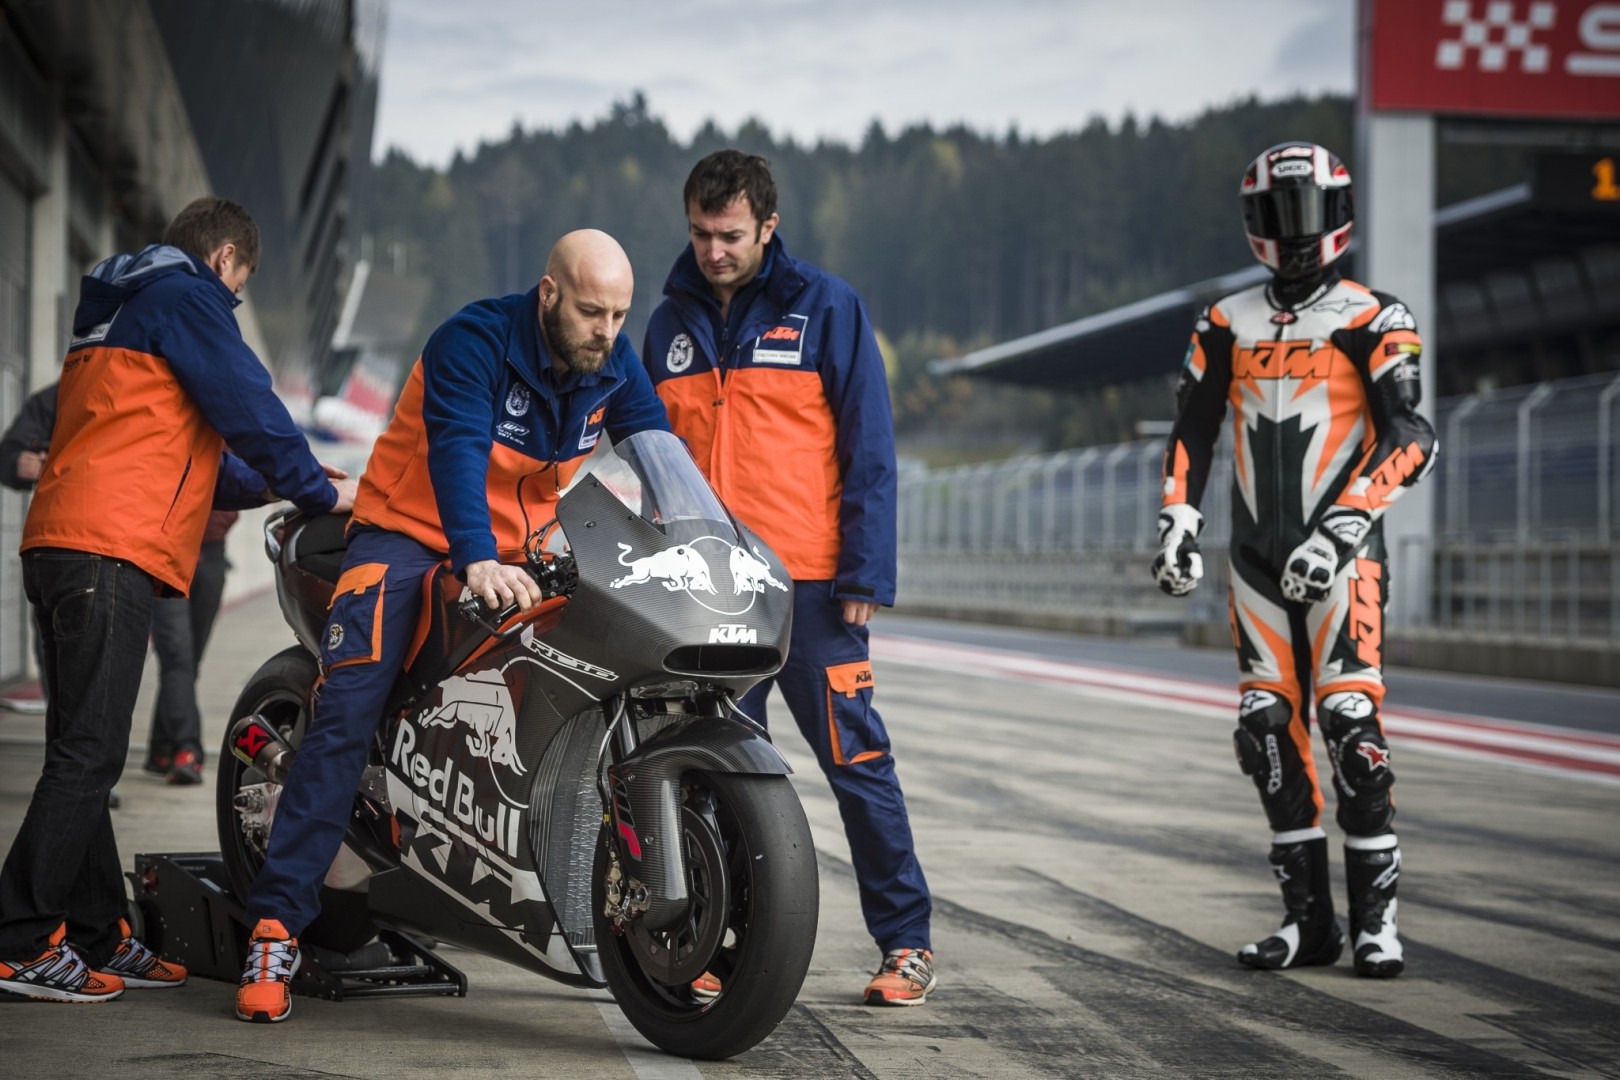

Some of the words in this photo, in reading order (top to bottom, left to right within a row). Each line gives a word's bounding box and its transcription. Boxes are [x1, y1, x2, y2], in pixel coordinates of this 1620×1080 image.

[762, 326, 800, 341] KTM
[1236, 339, 1334, 379] KTM
[1365, 440, 1425, 510] KTM
[707, 623, 757, 644] KTM
[1348, 557, 1382, 669] KTM
[391, 717, 454, 808] Red
[452, 770, 521, 859] Bull
